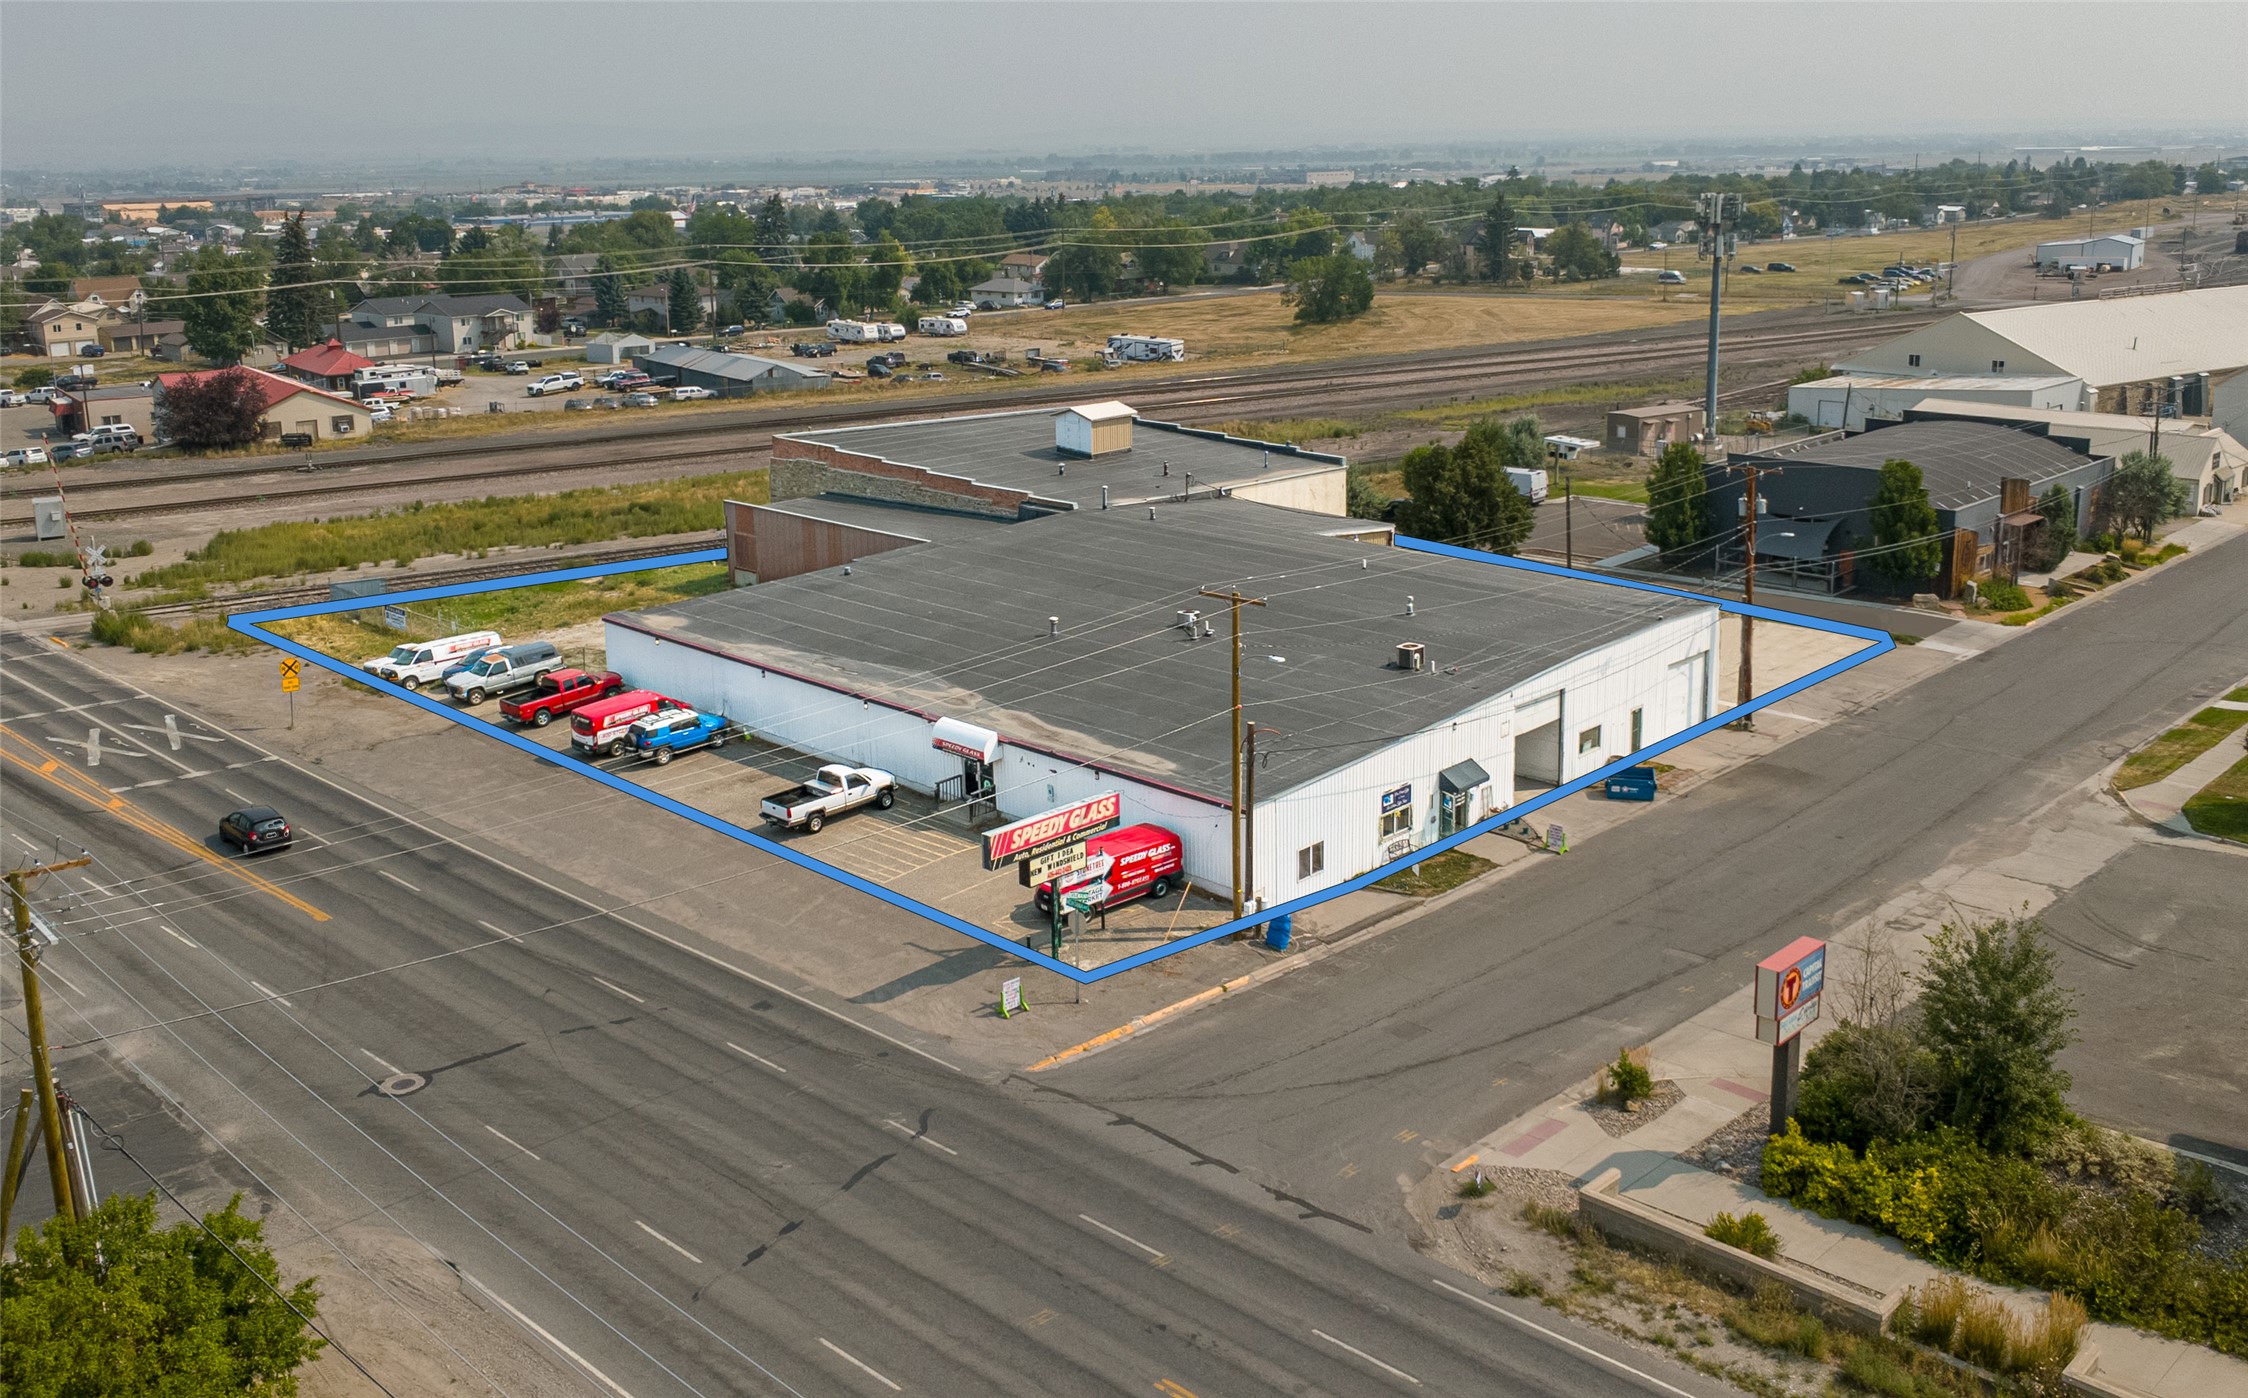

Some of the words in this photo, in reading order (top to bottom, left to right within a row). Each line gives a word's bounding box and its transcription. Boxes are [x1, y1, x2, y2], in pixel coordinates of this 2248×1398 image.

[942, 741, 962, 752] SPEEDY
[962, 746, 981, 757] GLASS
[1010, 812, 1070, 850] SPEEDY
[1069, 797, 1116, 829] GLASS
[1030, 836, 1067, 856] Residential
[1072, 821, 1108, 840] Commercial
[1030, 867, 1042, 877] NEW
[1047, 851, 1085, 871] WINDSHIELD
[1040, 853, 1054, 865] GIFT
[1120, 850, 1148, 866] SPEEDY
